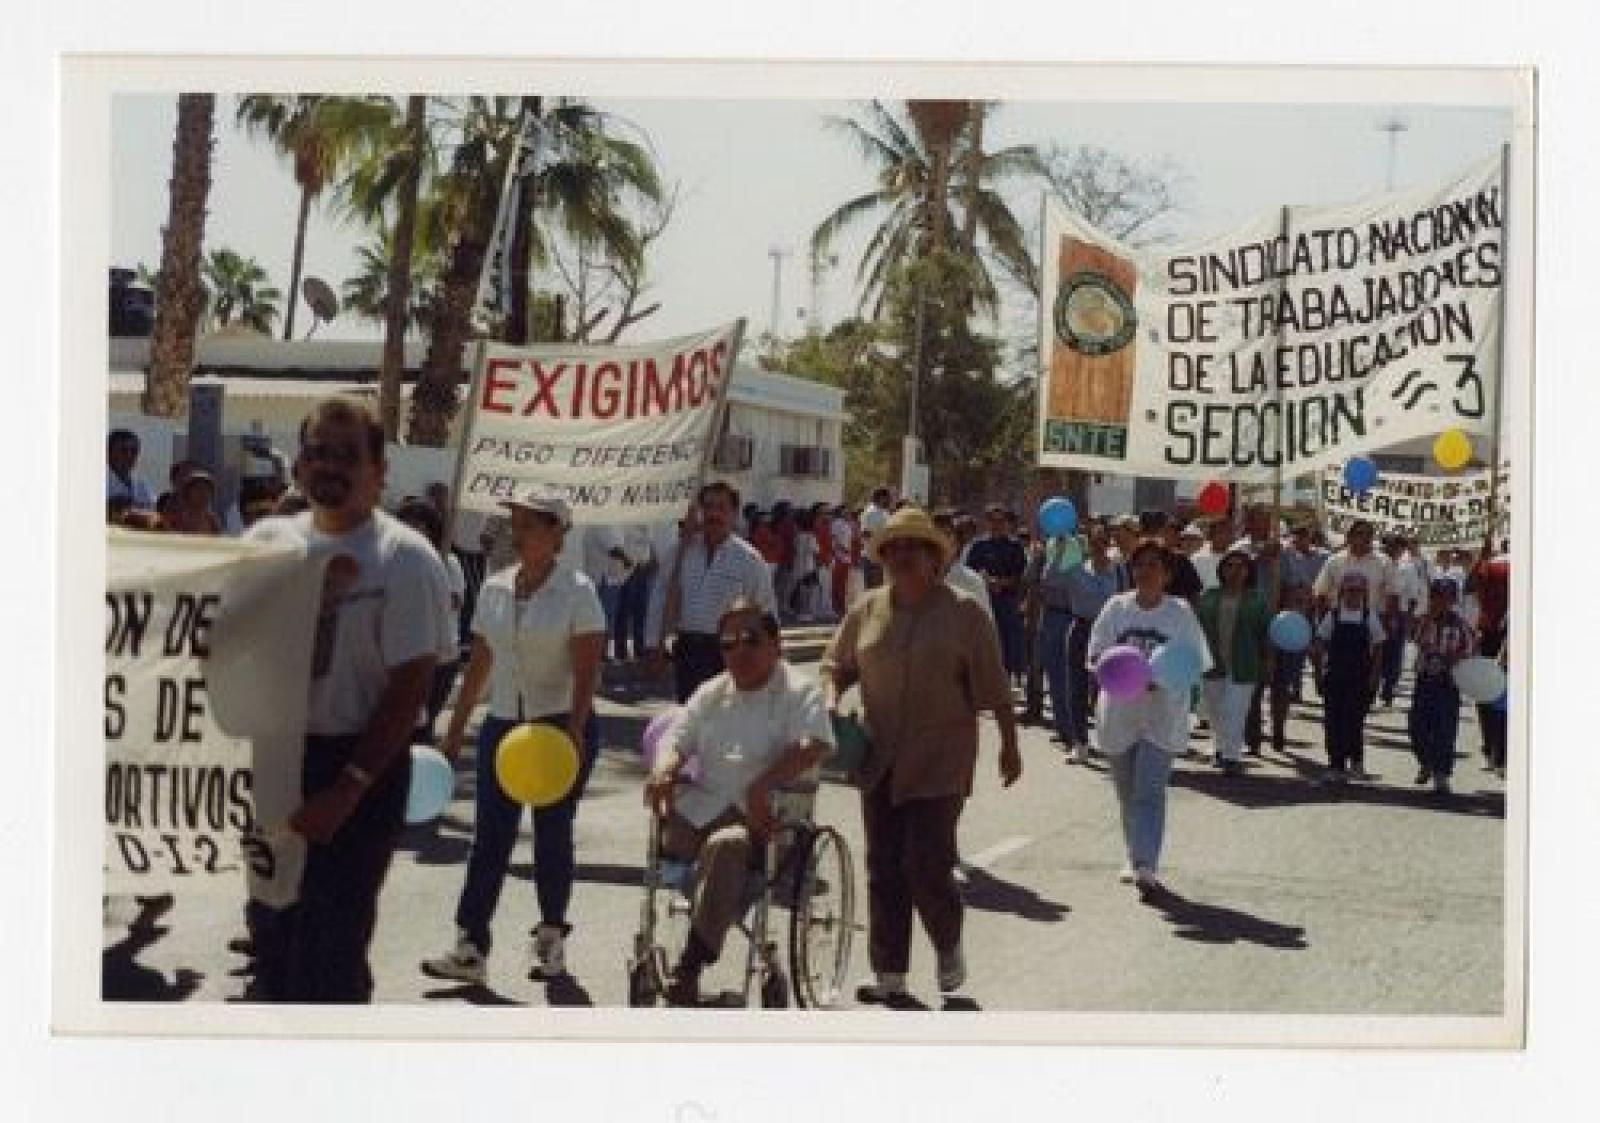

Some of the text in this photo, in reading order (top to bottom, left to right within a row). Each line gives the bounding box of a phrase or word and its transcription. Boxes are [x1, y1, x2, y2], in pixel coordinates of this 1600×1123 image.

[1167, 228, 1358, 296] SINDICATO
[1167, 300, 1219, 343] DE
[480, 339, 728, 420] EXIGIMOS
[1167, 351, 1216, 394] DE
[1230, 351, 1268, 394] LA
[1164, 354, 1486, 466] SECCION 3
[471, 436, 555, 466] PAGO
[1045, 420, 1127, 458] SNTE
[468, 472, 518, 498] DEL
[163, 592, 221, 659] DE
[154, 677, 206, 743] DE
